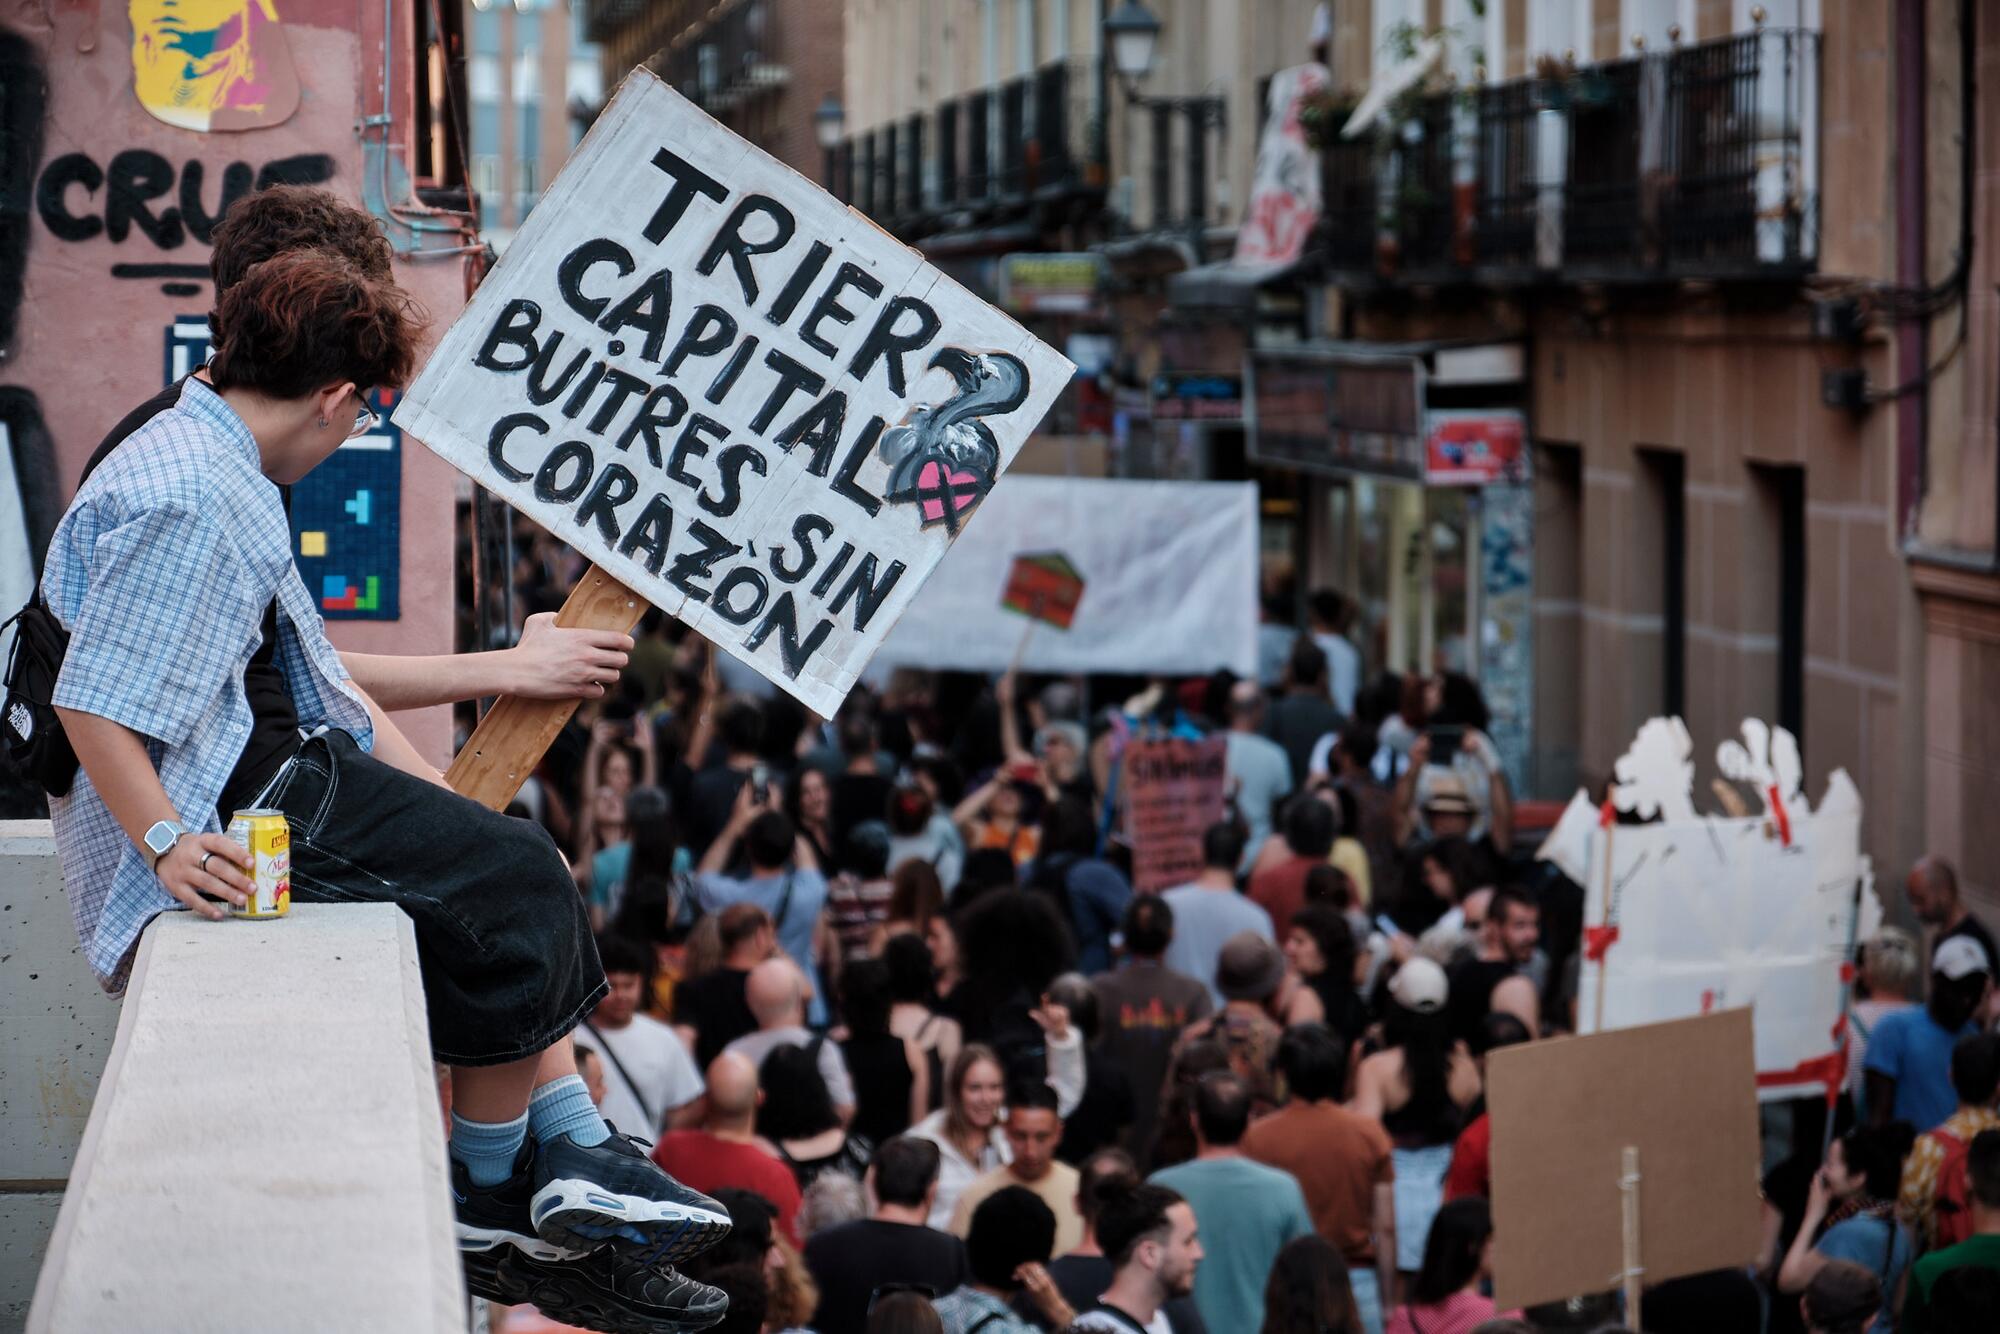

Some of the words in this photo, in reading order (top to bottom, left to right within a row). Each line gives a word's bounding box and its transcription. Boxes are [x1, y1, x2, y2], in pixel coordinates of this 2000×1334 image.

[557, 238, 888, 518] CAPITAL
[642, 147, 941, 398] TRIER
[769, 513, 906, 633] SIN
